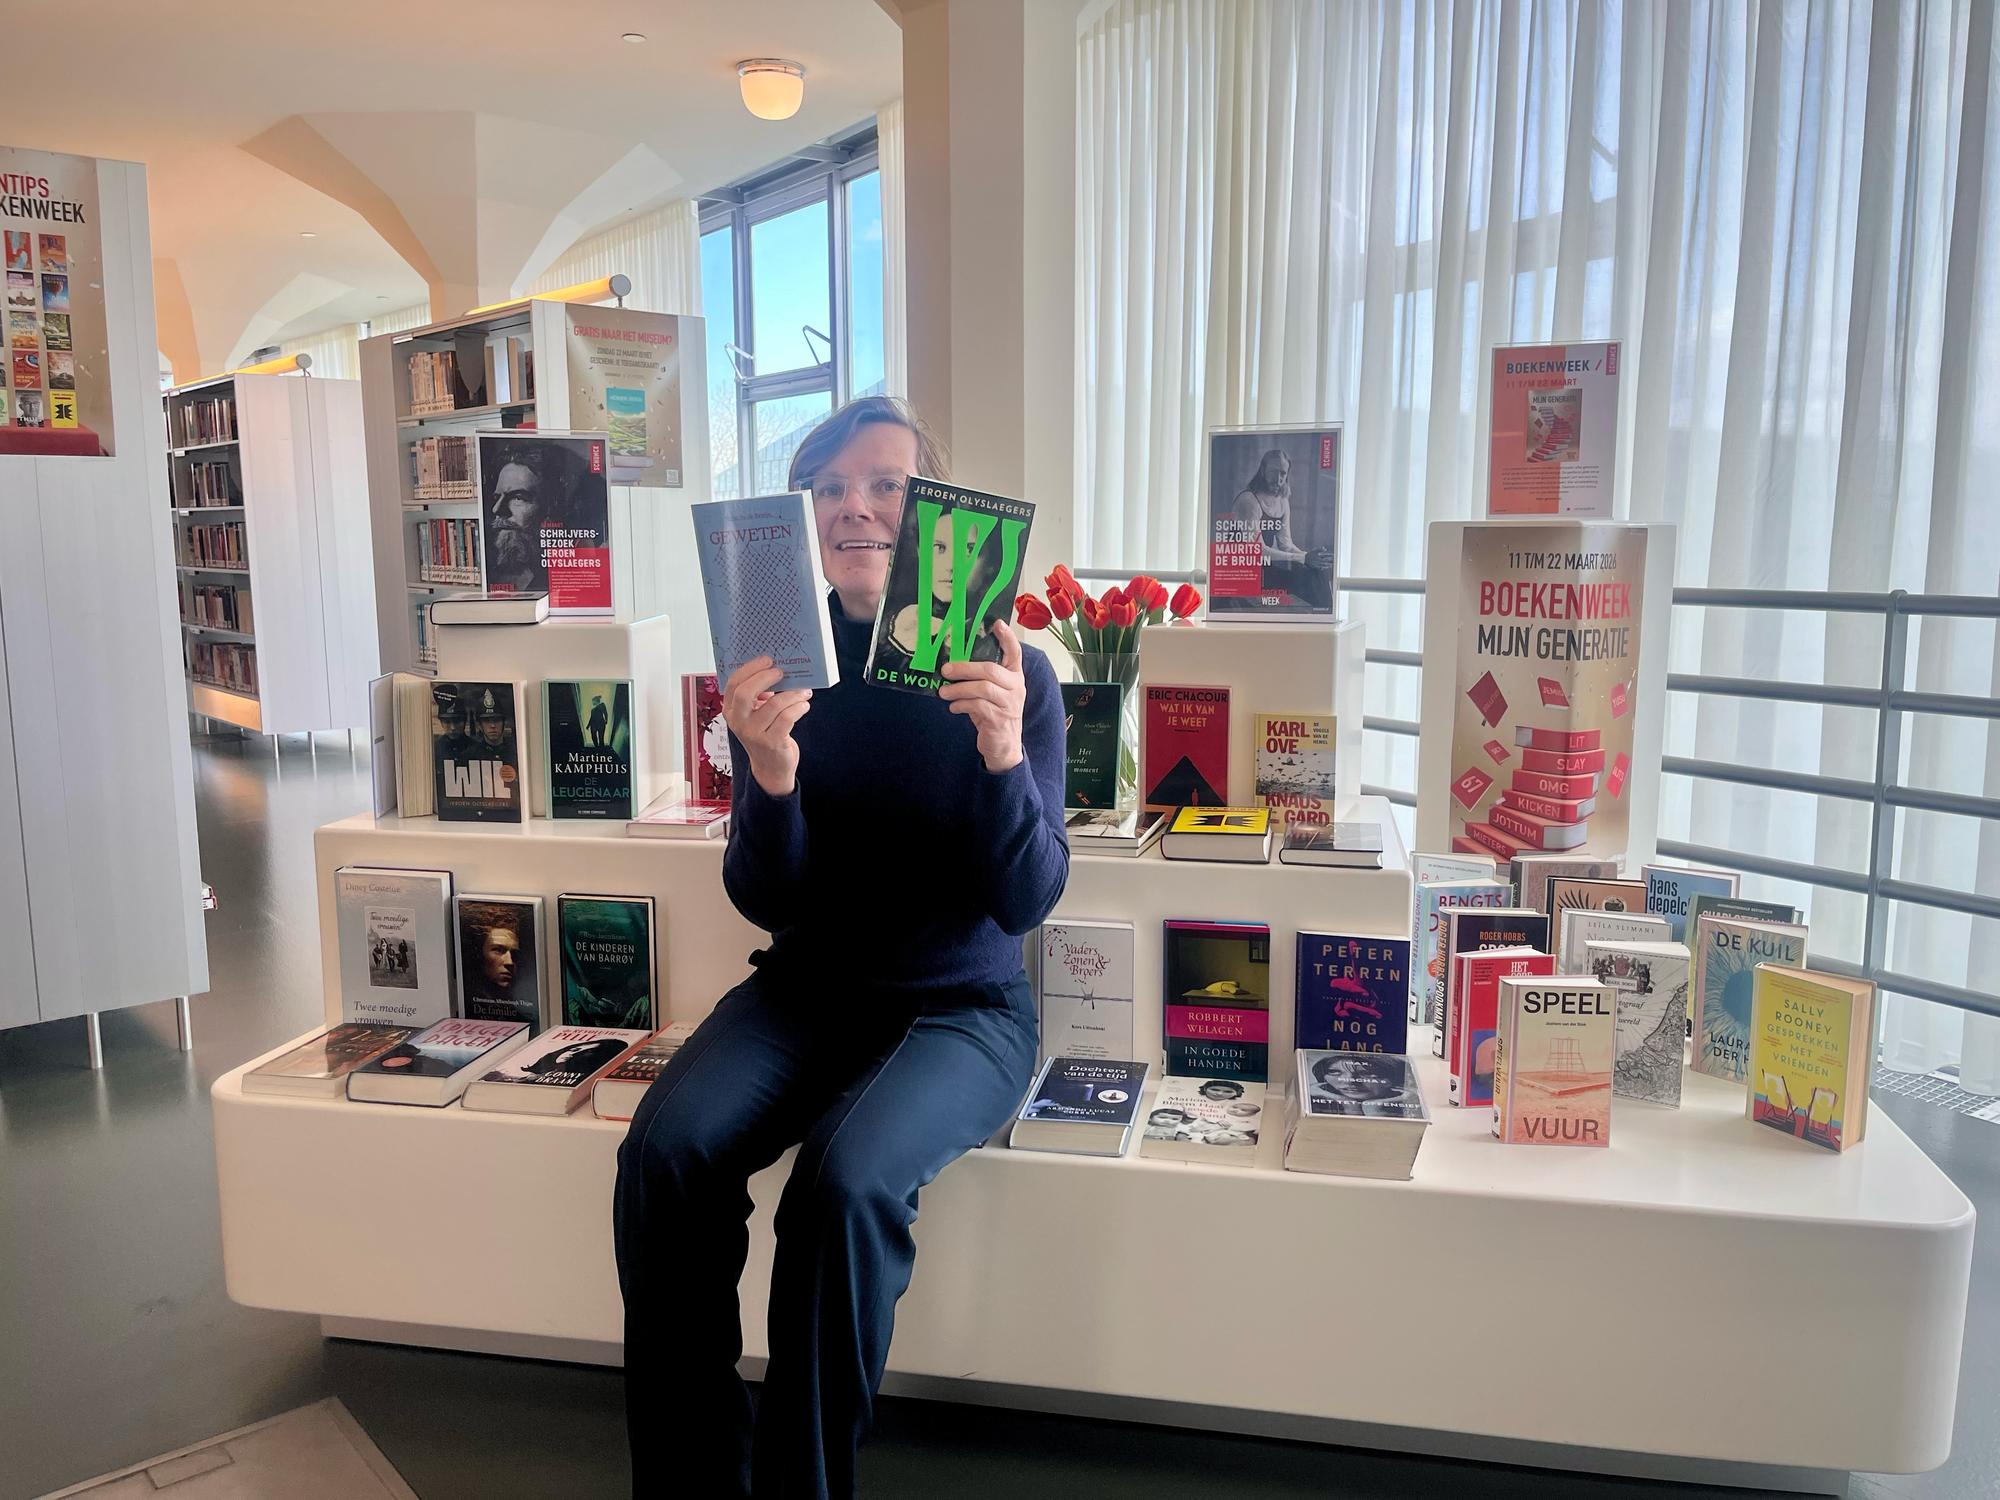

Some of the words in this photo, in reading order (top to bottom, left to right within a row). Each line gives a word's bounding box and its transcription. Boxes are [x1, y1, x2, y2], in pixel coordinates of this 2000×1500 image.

[1506, 359, 1590, 374] BOEKENWEEK
[1550, 378, 1577, 387] MAART
[914, 485, 957, 501] JEROEN
[959, 494, 1032, 517] OLYSLAEGERS
[540, 529, 599, 538] SCHRIJVERS-
[710, 524, 792, 545] GEWETEN
[541, 549, 576, 558] JEROEN
[1215, 543, 1261, 555] MAURITS
[541, 558, 601, 568] OLYSLAEGERS
[1215, 555, 1229, 566] DE
[1231, 555, 1272, 566] BRUIJN
[1508, 552, 1521, 569] 11
[1525, 552, 1544, 569] T/M
[1548, 552, 1561, 570] 22
[1564, 553, 1599, 570] MAART
[1600, 552, 1617, 570] 2026
[1262, 596, 1280, 606] WEEK
[1479, 580, 1632, 620] BOEKENWEEK
[1477, 624, 1530, 658] MIJN
[1536, 626, 1630, 661] GENERATIE
[877, 668, 897, 683] DE
[1149, 689, 1172, 700] ERIC
[1175, 690, 1229, 703] CHACOUR
[1160, 703, 1180, 713] WAT
[1182, 703, 1193, 714] IK
[1196, 704, 1215, 715] VAN
[1167, 716, 1177, 726] JE
[1180, 716, 1207, 728] WEET
[1266, 720, 1310, 738] KARL
[1266, 737, 1299, 754] OVE
[1569, 736, 1585, 749] LIT
[568, 752, 613, 762] Martine
[1556, 758, 1586, 771] SLAY
[555, 763, 627, 774] KAMPHUIS
[443, 760, 511, 799] WIL
[584, 777, 598, 786] DE
[1460, 775, 1484, 793] 67
[1539, 779, 1569, 794] OMG
[553, 786, 630, 798] LEUGENAAR
[1265, 793, 1322, 810] KNAUS
[1518, 797, 1561, 818] KICKEN
[1284, 810, 1330, 828] GARD
[1493, 813, 1537, 841] JOTTUM
[1473, 829, 1507, 854] MIETERS
[1650, 874, 1678, 897] hans
[1649, 895, 1691, 916] depelc
[1438, 920, 1448, 949] ROGER
[1479, 931, 1502, 941] ROGER
[1503, 932, 1526, 942] HOBBS
[576, 941, 587, 951] DE
[590, 942, 635, 954] KINDEREN
[1322, 944, 1393, 961] PETER
[1716, 932, 1742, 950] DE
[1750, 938, 1795, 962] KUIL
[577, 952, 596, 962] VAN
[598, 953, 634, 965] BARRØY
[1063, 954, 1094, 966] Zonen
[1069, 965, 1103, 978] Broers
[1313, 963, 1400, 982] TERRIN
[1511, 961, 1529, 973] HET
[354, 1001, 377, 1012] Twee
[379, 1001, 417, 1017] moedige
[1433, 979, 1445, 1027] SPOOKMAN
[1523, 991, 1610, 1015] SPEEL
[1784, 999, 1824, 1018] SALLY
[354, 1017, 393, 1026] vrouwen
[1188, 1012, 1243, 1024] ROBBERT
[1775, 1011, 1832, 1036] ROONEY
[1187, 1024, 1243, 1036] WELAGEN
[1334, 1020, 1377, 1036] NOG
[1767, 1023, 1839, 1052] GESPREKKEN
[1184, 1045, 1197, 1055] IN
[1202, 1047, 1246, 1059] GOEDE
[1326, 1039, 1383, 1054] LANG
[1790, 1043, 1813, 1057] MET
[1713, 1047, 1739, 1063] DER
[1069, 1065, 1127, 1074] Dochters
[1188, 1058, 1242, 1071] HANDEN
[1773, 1052, 1829, 1078] VRIENDEN
[535, 1076, 577, 1085] BRAAM
[545, 1071, 584, 1079] CONNY
[1106, 1072, 1127, 1080] tijd
[1523, 1117, 1599, 1140] VUUR
